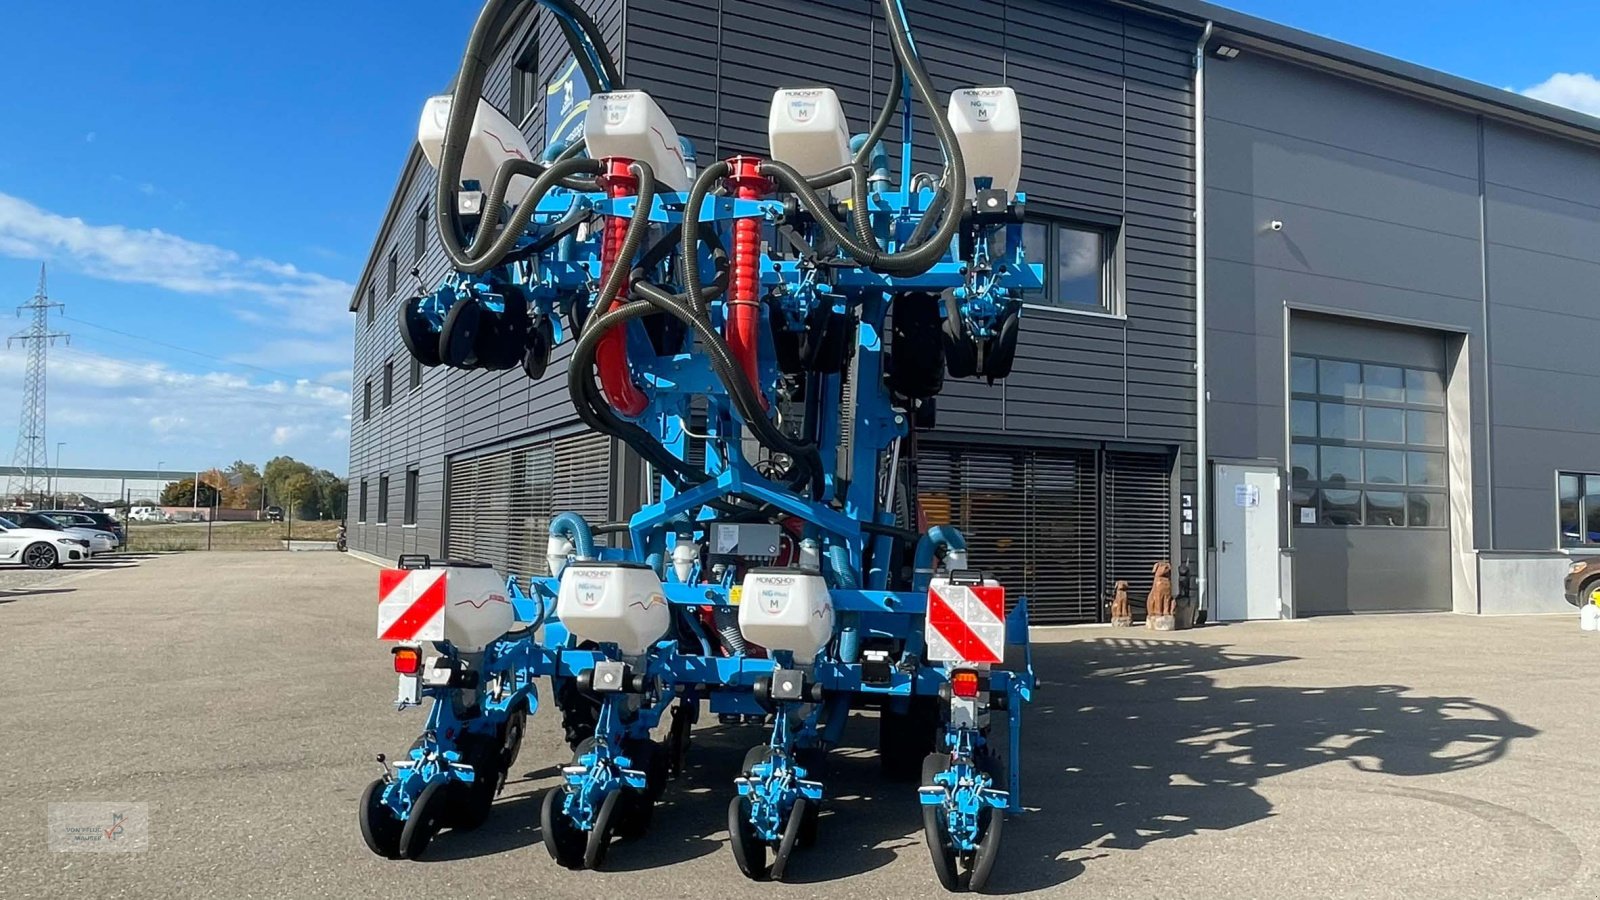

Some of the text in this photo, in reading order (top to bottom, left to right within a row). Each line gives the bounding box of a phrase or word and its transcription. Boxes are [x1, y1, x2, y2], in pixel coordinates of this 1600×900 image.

[611, 112, 619, 120] M
[799, 109, 807, 117] M
[978, 109, 987, 117] M
[585, 592, 594, 601] M
[770, 600, 778, 608] M
